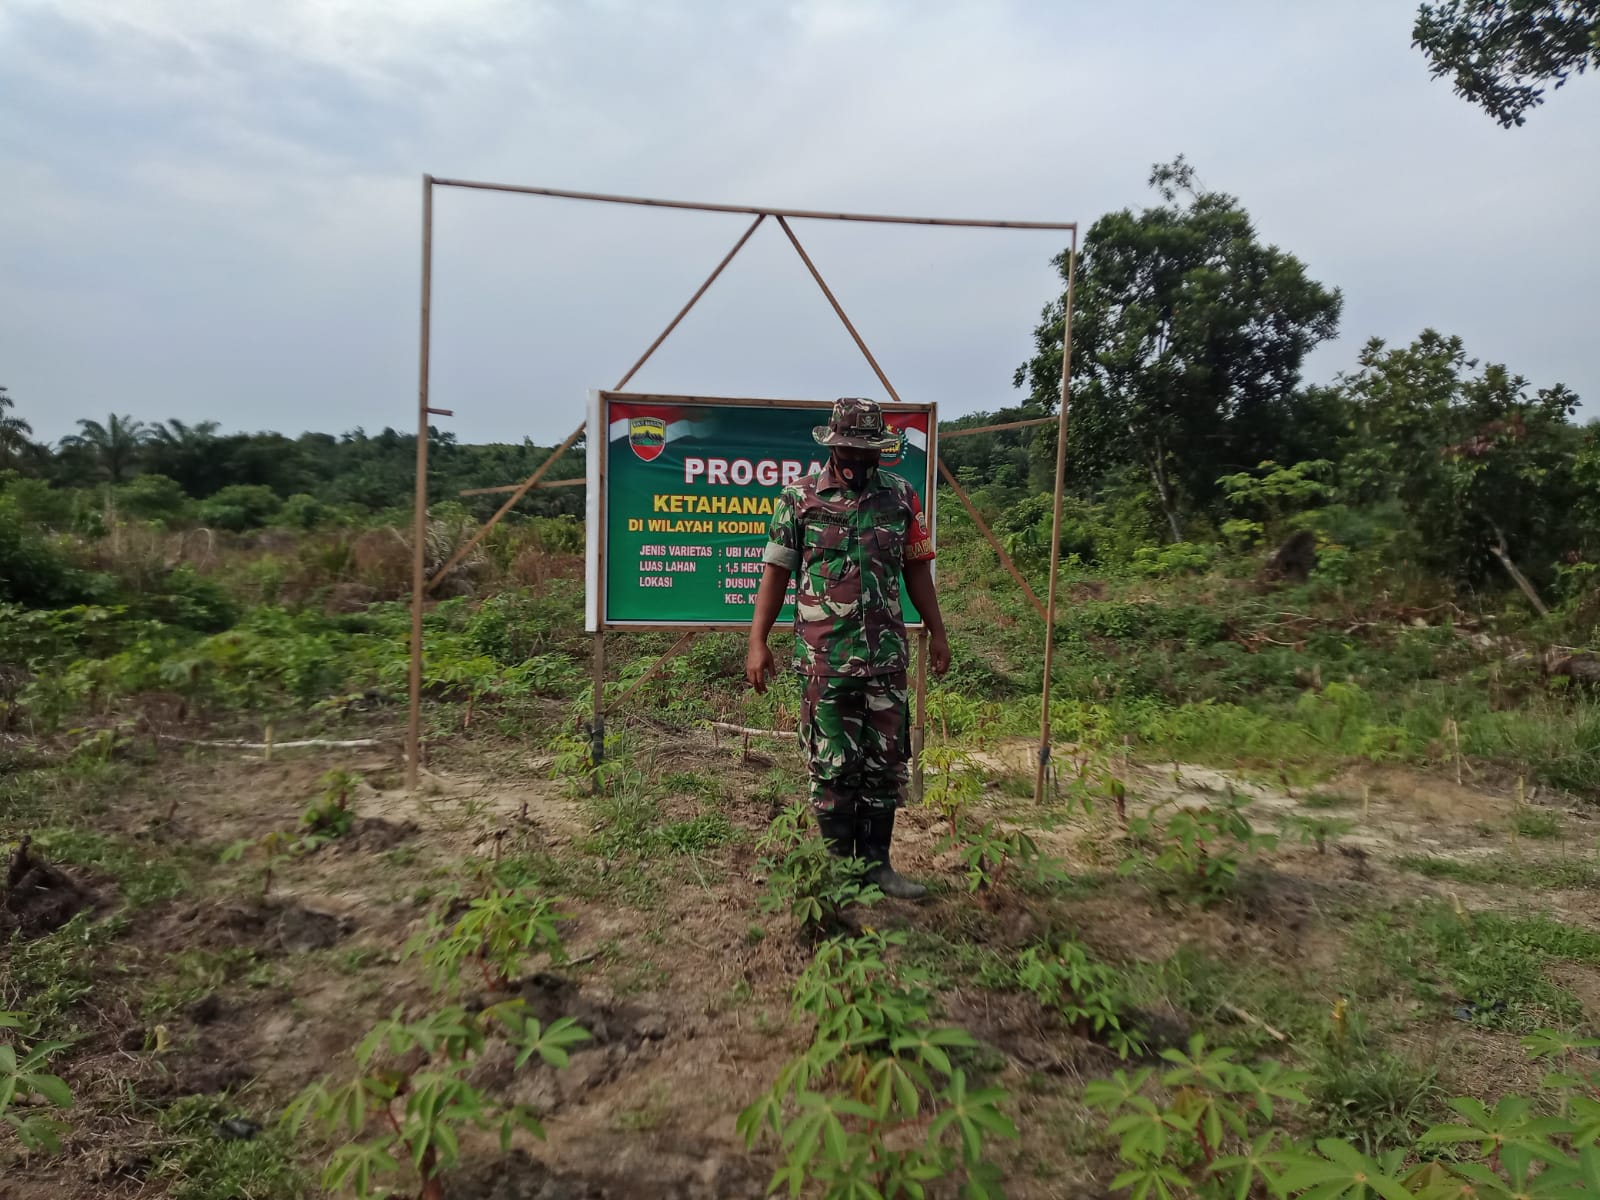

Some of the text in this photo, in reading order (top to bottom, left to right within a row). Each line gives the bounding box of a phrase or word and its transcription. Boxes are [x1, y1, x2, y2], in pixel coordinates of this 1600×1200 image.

[628, 519, 766, 534] DI WILAYAH KODIM
[639, 545, 666, 556] JENIS
[668, 546, 713, 557] VARIETAS
[725, 547, 742, 558] UBI
[639, 561, 663, 572] LUAS
[665, 561, 696, 572] LAHAN
[725, 562, 739, 575] 1,5
[639, 576, 673, 588] LOKASI
[725, 578, 757, 589] DUSUN
[724, 593, 746, 604] KEC.
